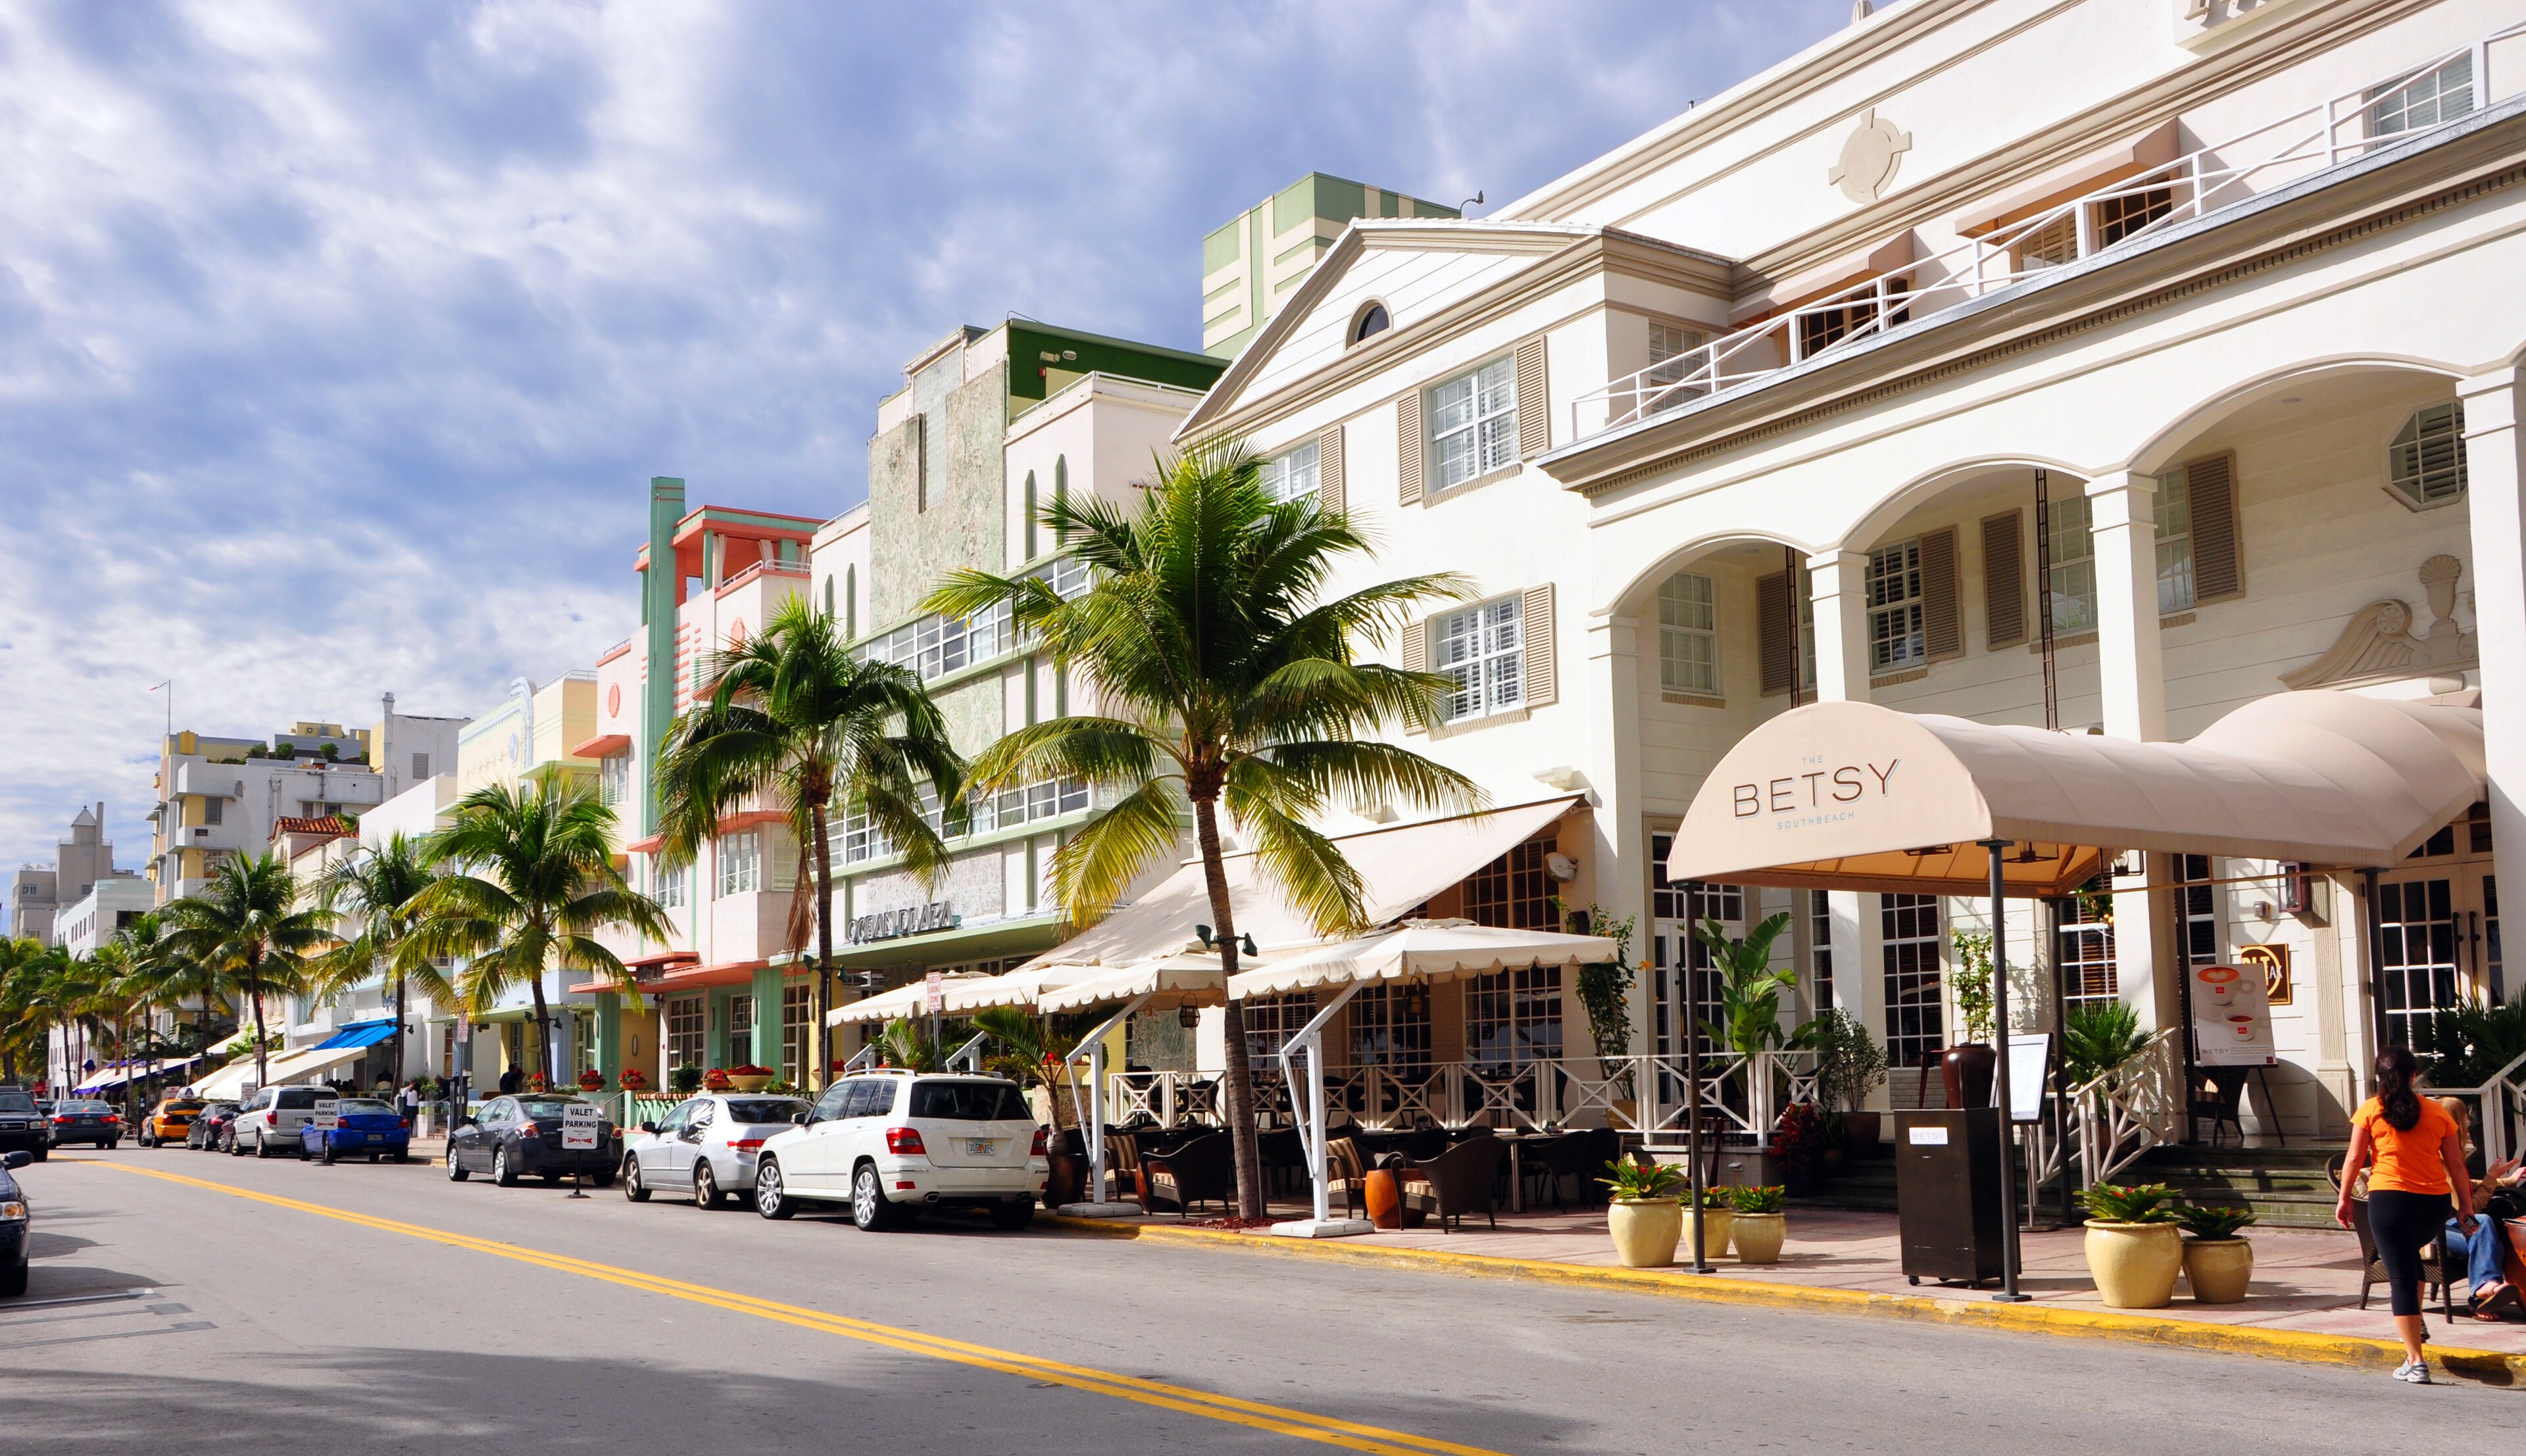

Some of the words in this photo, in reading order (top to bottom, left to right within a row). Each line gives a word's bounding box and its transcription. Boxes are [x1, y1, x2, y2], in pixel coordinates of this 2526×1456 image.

[1802, 755, 1823, 765] THE
[1734, 759, 1901, 820] BETSY
[1777, 812, 1854, 830] SOUTHBEACH
[848, 910, 897, 942] OCEAN
[899, 900, 953, 933] PLAZA
[565, 1120, 597, 1128] PARKING
[1912, 1132, 1944, 1140] BETSY
